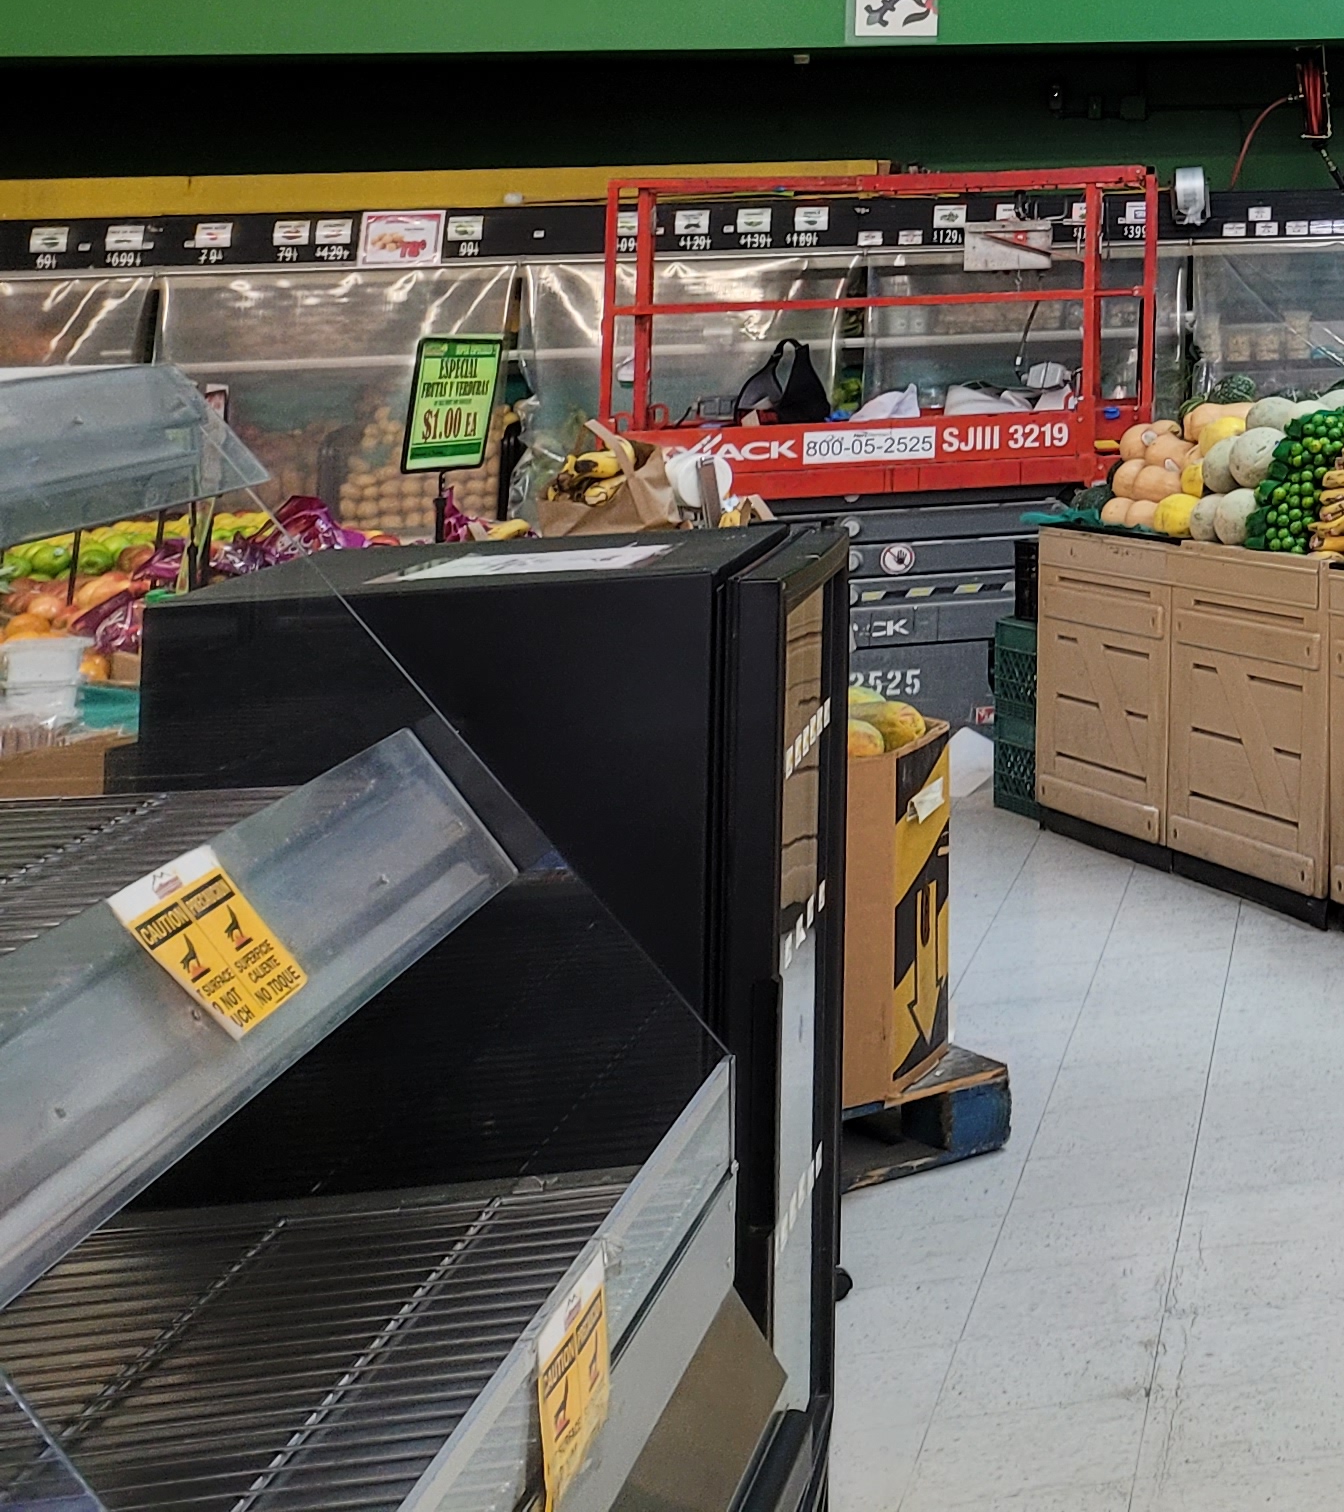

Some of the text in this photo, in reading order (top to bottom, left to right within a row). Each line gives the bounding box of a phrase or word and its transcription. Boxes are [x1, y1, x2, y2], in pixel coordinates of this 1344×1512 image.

[438, 358, 478, 380] ESPECIAL
[422, 407, 478, 444] $1.00 EA
[1008, 423, 1069, 449] 3219
[806, 435, 933, 457] 800-05-2525
[140, 906, 190, 946] CAUTION
[202, 968, 236, 997] SURFACE
[248, 955, 281, 984] CALIENTE
[220, 986, 244, 1009] NOT
[254, 965, 301, 1006] NO TOQUE
[229, 1004, 256, 1028] UCH
